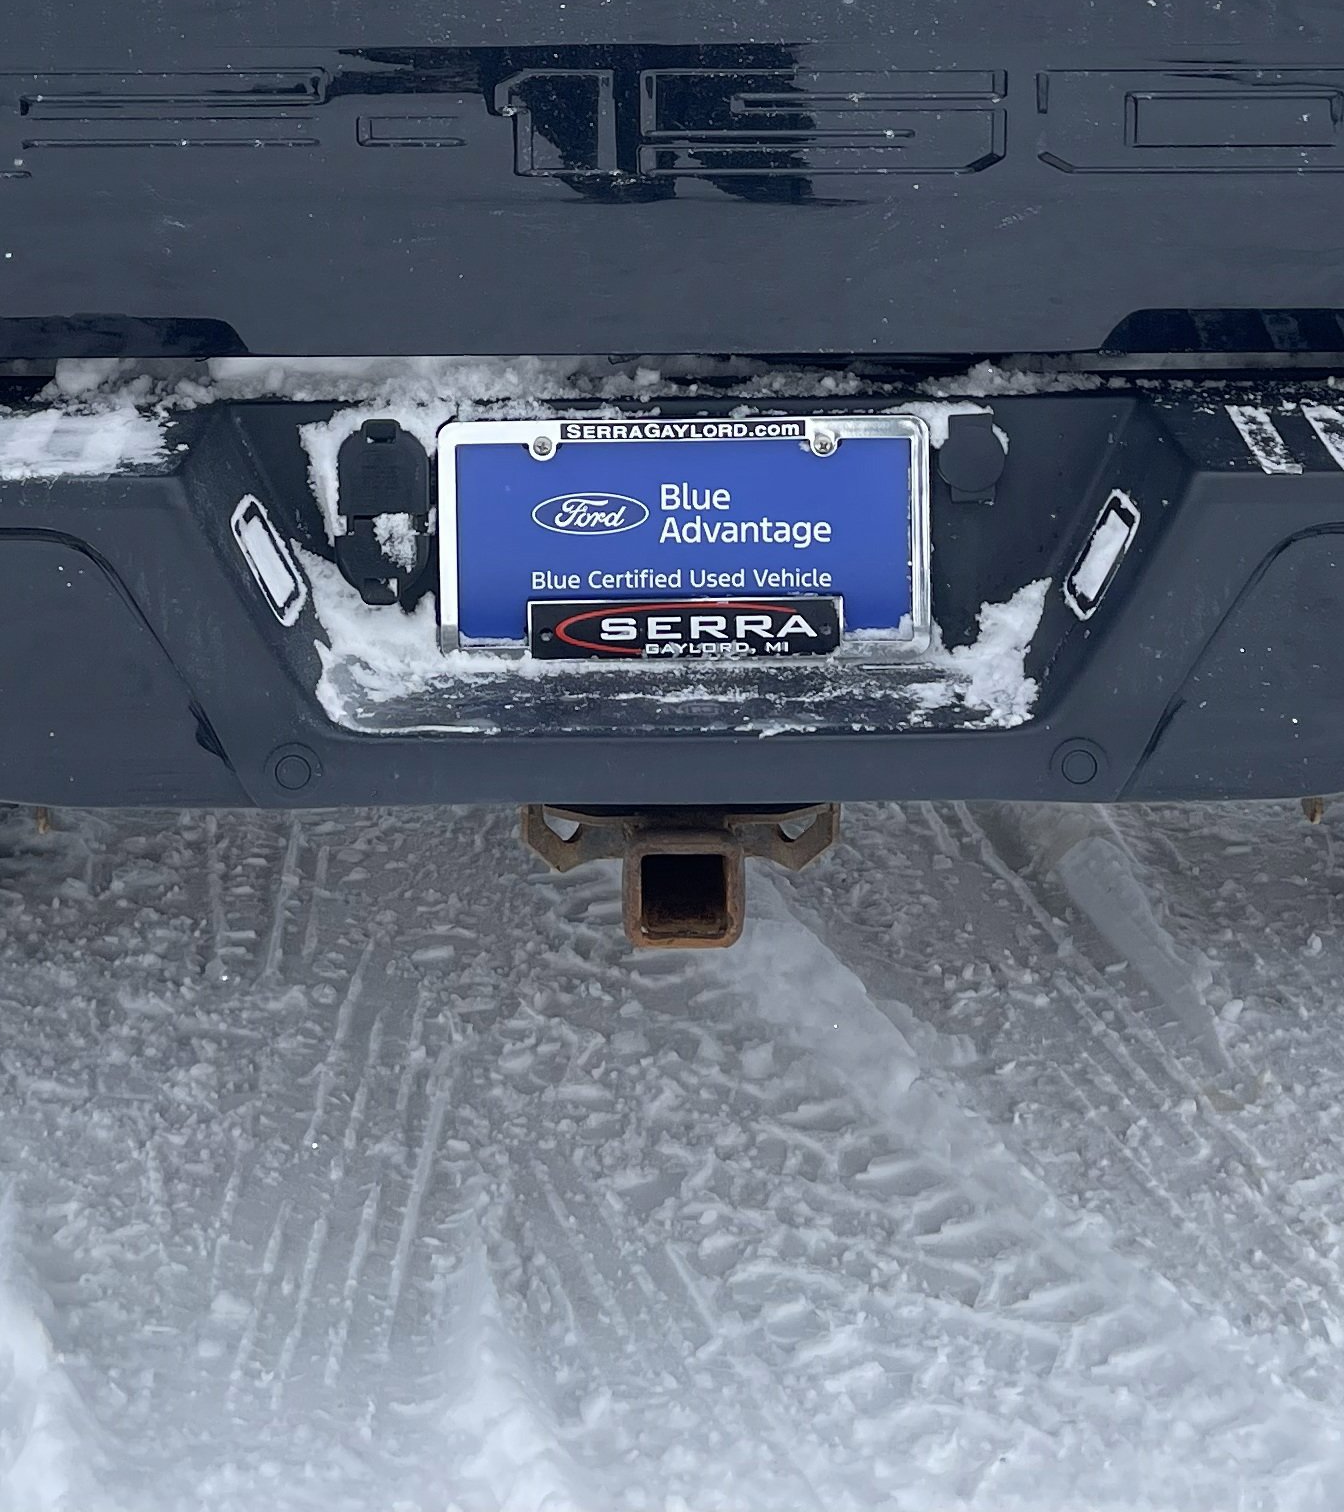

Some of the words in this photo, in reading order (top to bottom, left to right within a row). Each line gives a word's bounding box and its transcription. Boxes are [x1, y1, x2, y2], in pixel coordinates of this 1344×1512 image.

[566, 422, 800, 439] SERRAGAYLORD.com
[660, 482, 731, 511] Blue
[555, 498, 627, 528] Ford
[659, 515, 833, 548] Advantage
[531, 571, 581, 589] Blue
[587, 569, 682, 589] Certified
[689, 569, 746, 588] Used
[752, 567, 833, 588] Vehicle
[599, 614, 819, 641] SERRA
[645, 641, 757, 655] GAYLORD,
[765, 640, 790, 653] MI
